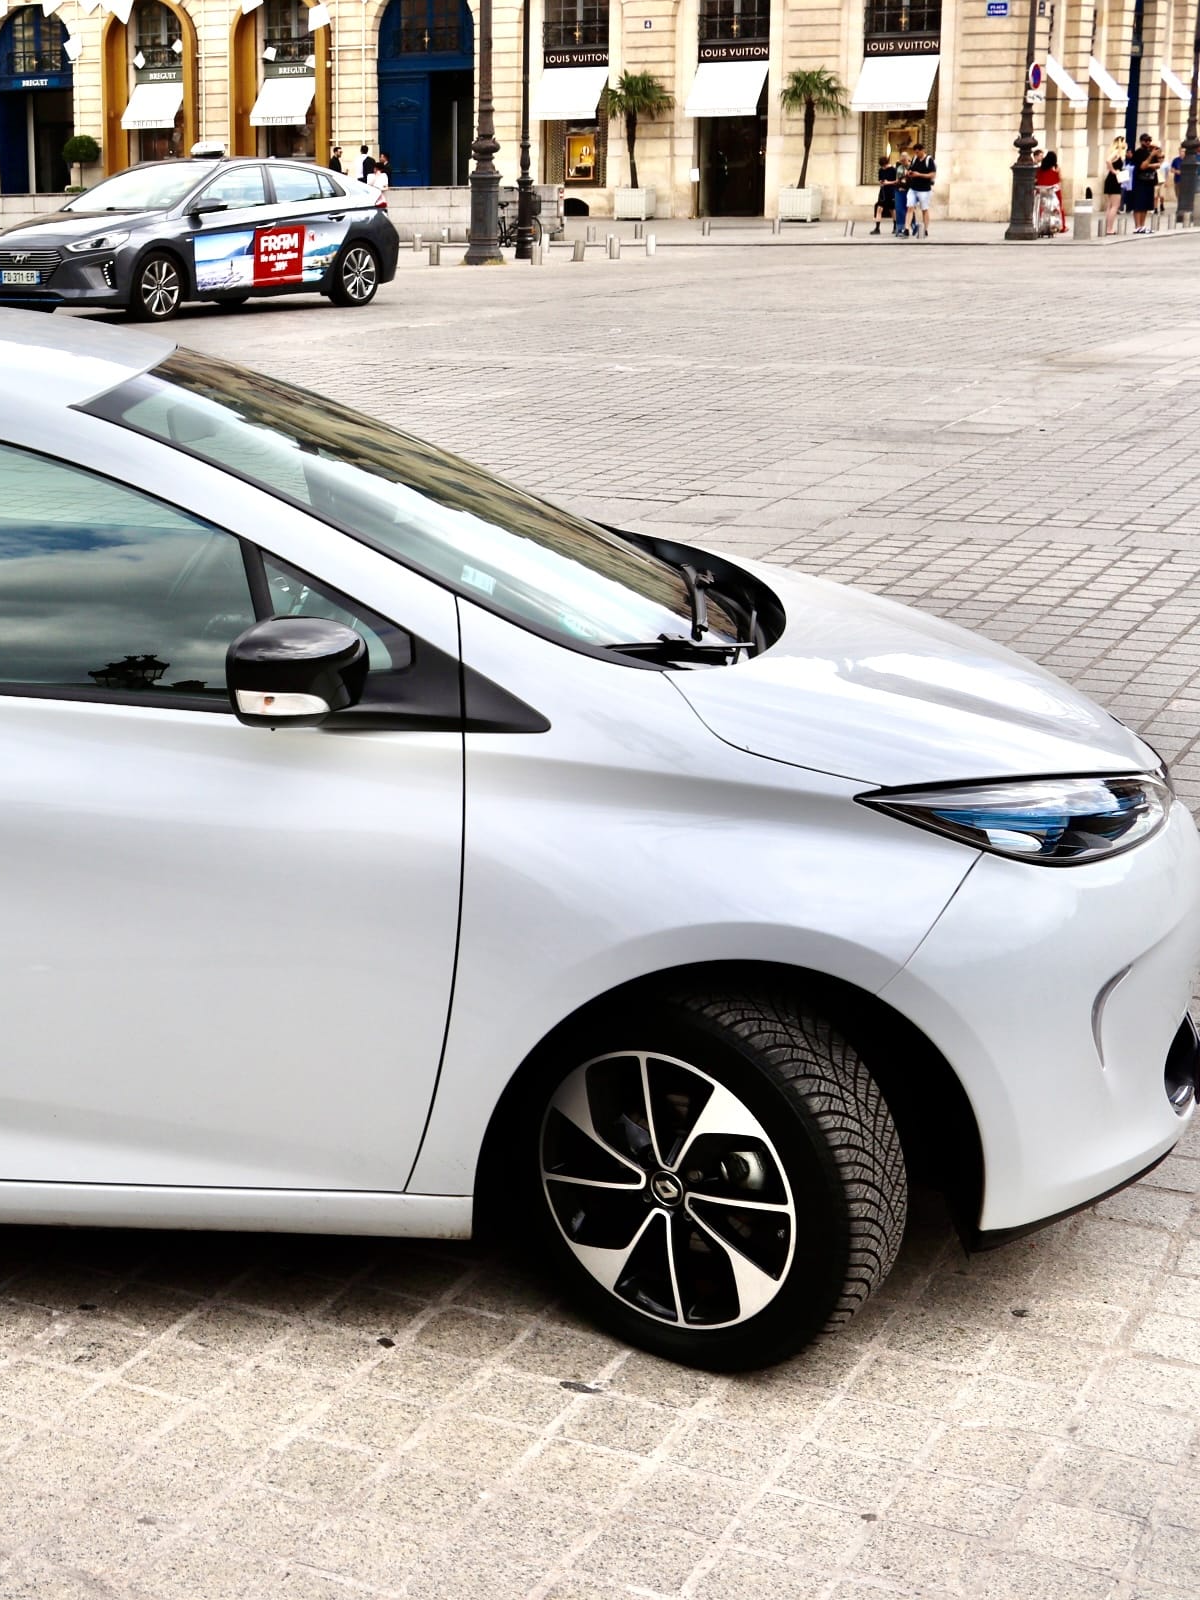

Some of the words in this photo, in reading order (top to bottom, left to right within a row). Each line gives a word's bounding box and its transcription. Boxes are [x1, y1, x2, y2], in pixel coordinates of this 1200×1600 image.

[866, 42, 895, 51] LOUIS
[897, 40, 939, 50] VUITTON
[700, 48, 727, 57] LOUIS
[729, 46, 768, 56] VUITTON
[545, 54, 570, 63] LOUIS
[572, 53, 609, 62] VUITTON
[278, 66, 307, 74] BREGUET
[149, 72, 177, 80] BREGUET
[260, 232, 299, 252] FRAM
